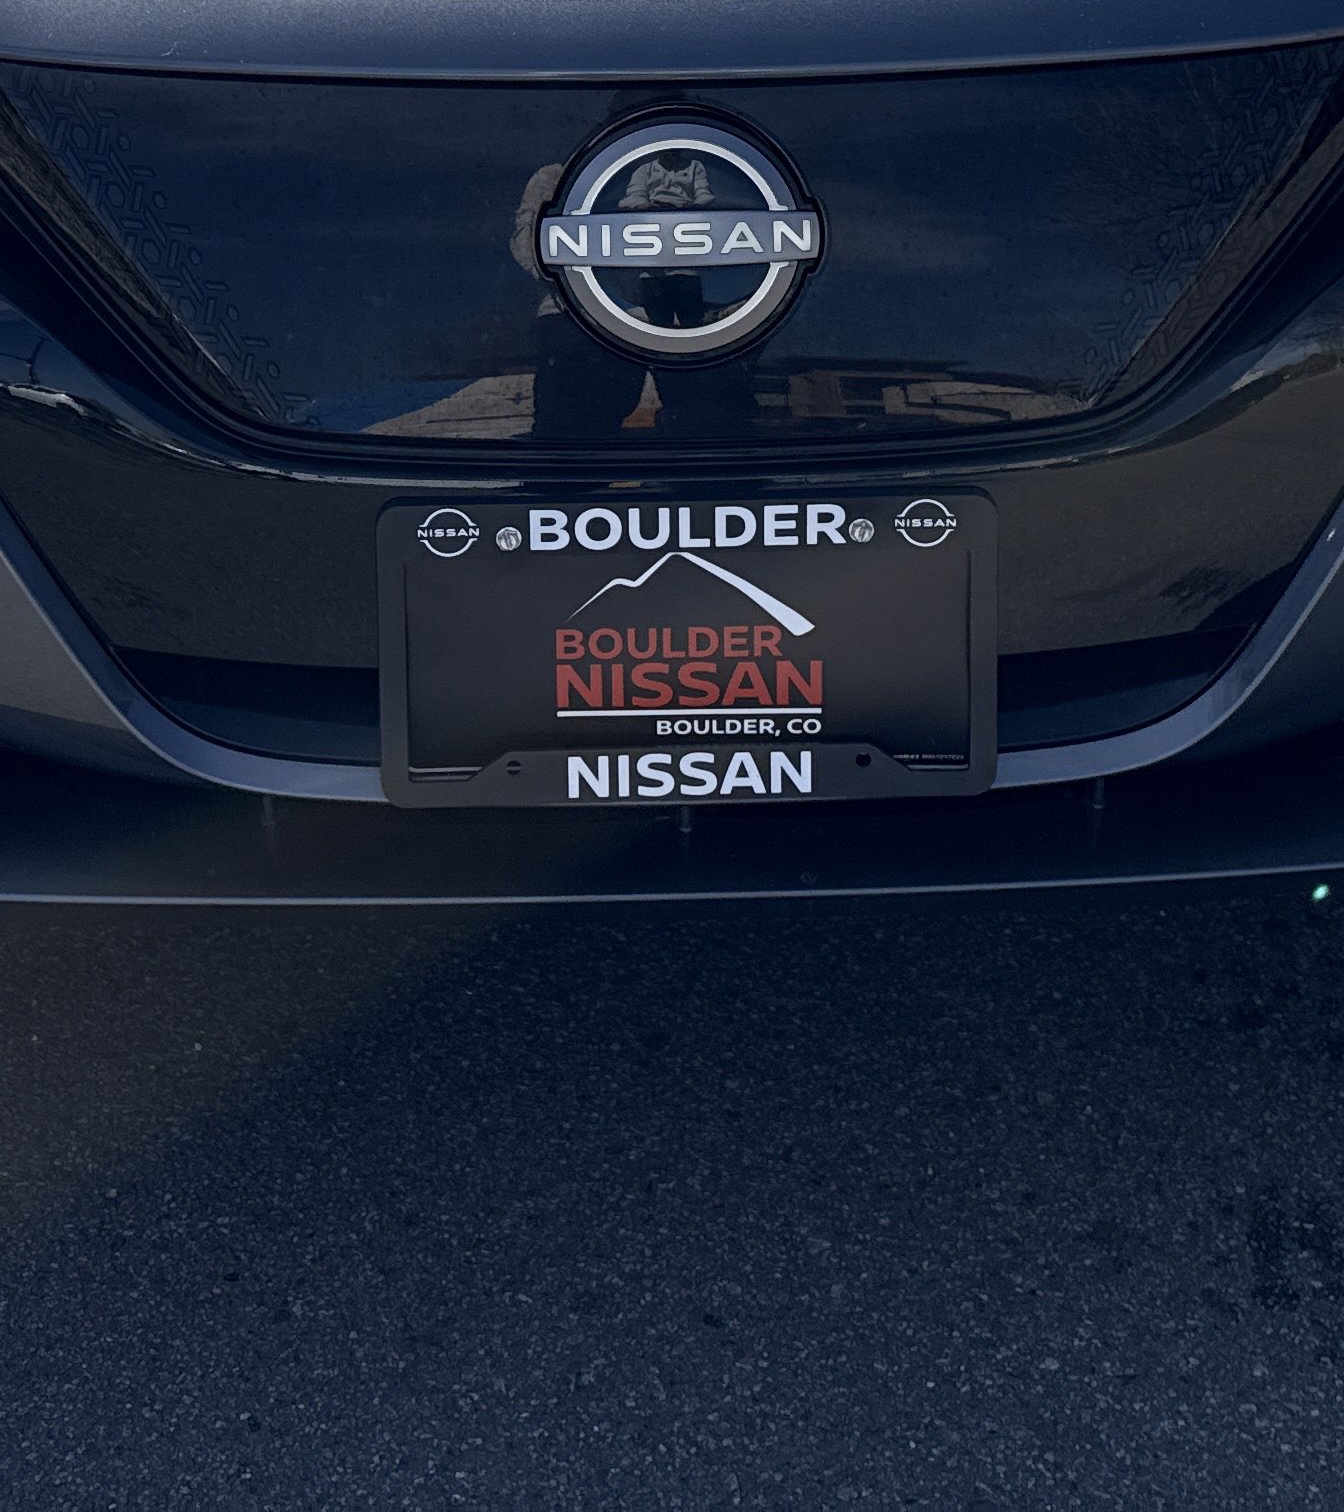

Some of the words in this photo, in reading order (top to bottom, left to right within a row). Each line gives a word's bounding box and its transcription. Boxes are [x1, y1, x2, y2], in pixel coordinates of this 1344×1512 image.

[548, 219, 812, 257] NISSAN
[417, 527, 480, 538] NISSAN
[529, 503, 847, 551] BOULDER
[894, 518, 957, 528] NISSAN
[556, 625, 783, 660] BOULDER
[556, 660, 823, 708] NISSAN
[656, 718, 781, 737] BOULDER,
[787, 718, 822, 734] CO
[567, 750, 812, 799] NISSAN
